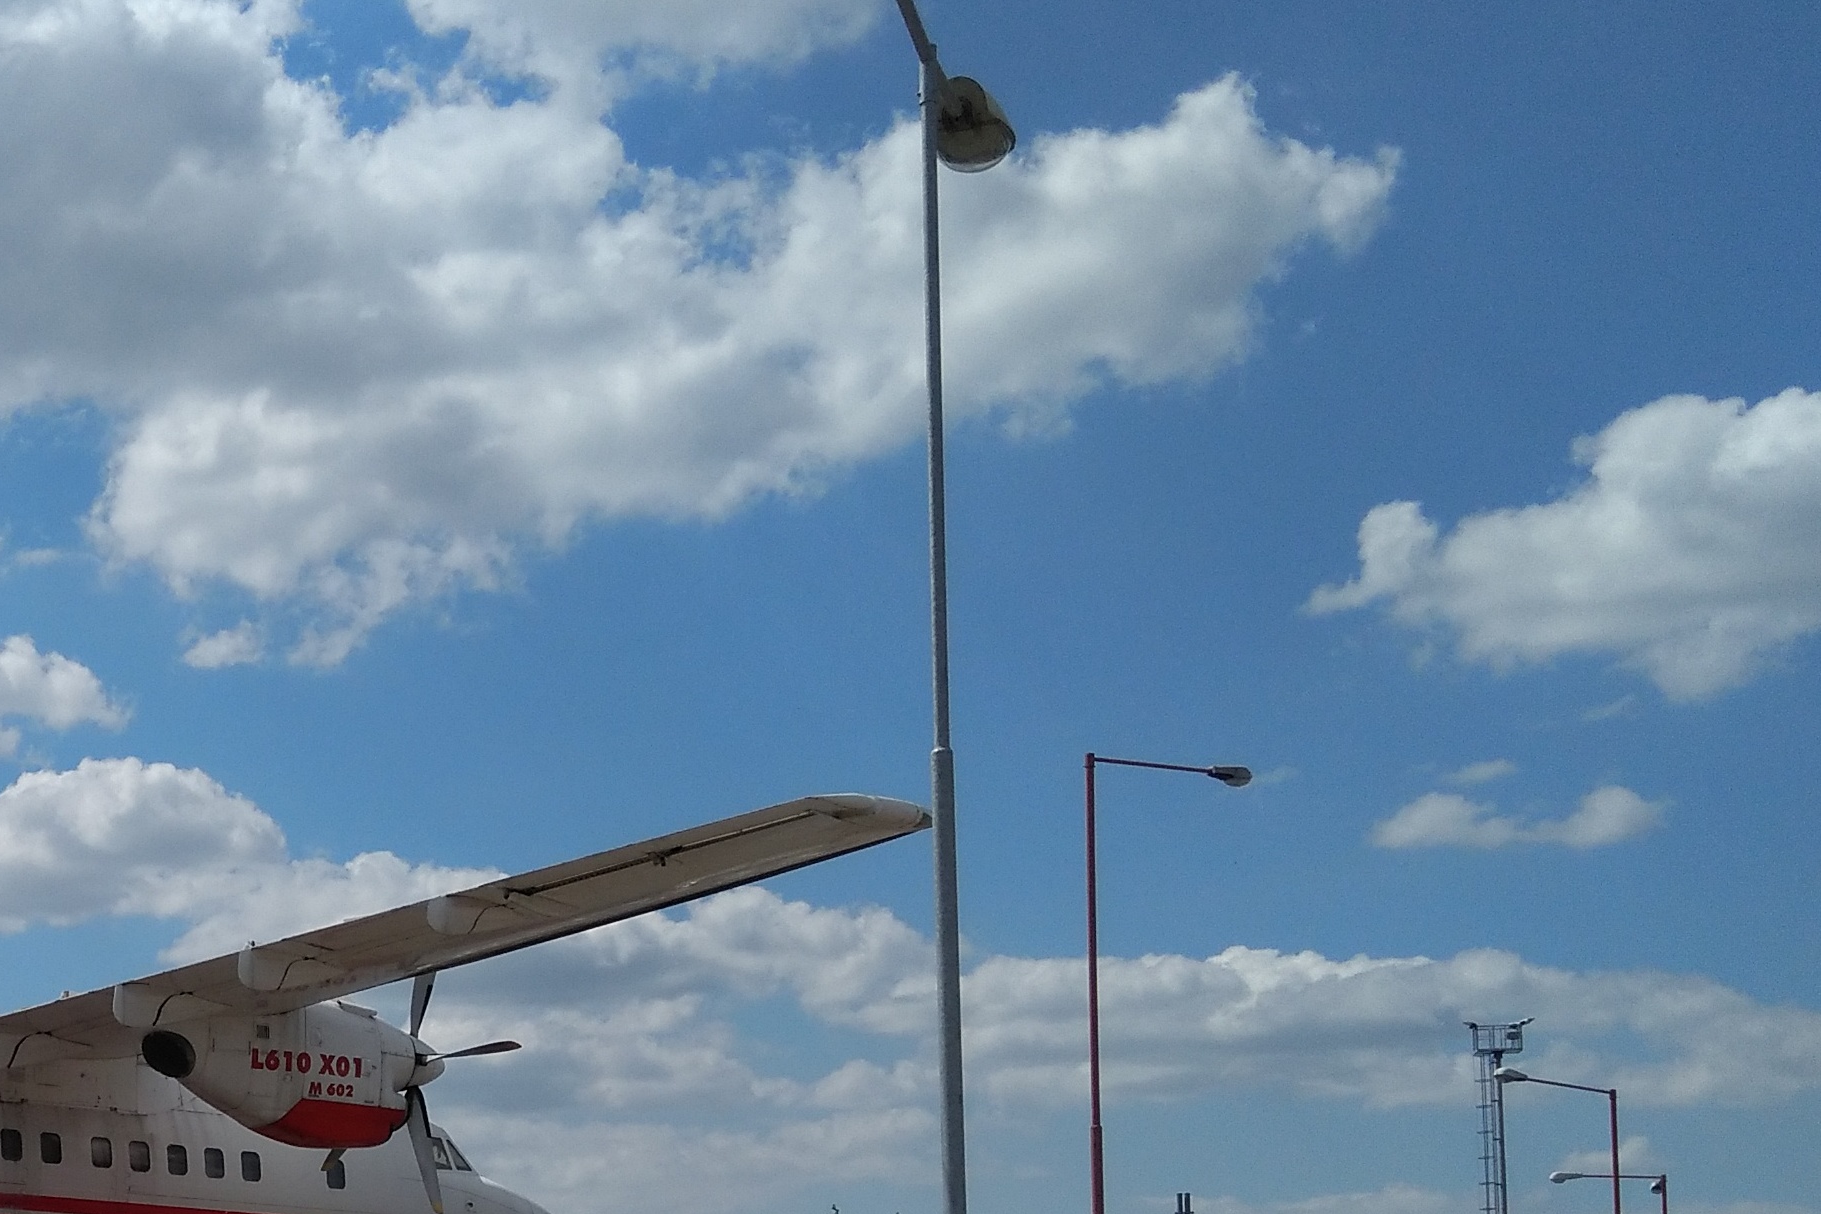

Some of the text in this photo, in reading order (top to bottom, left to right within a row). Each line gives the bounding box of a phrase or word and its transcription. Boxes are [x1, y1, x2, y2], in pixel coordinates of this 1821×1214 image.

[250, 1048, 362, 1078] L610 X01
[309, 1082, 353, 1097] M 602
